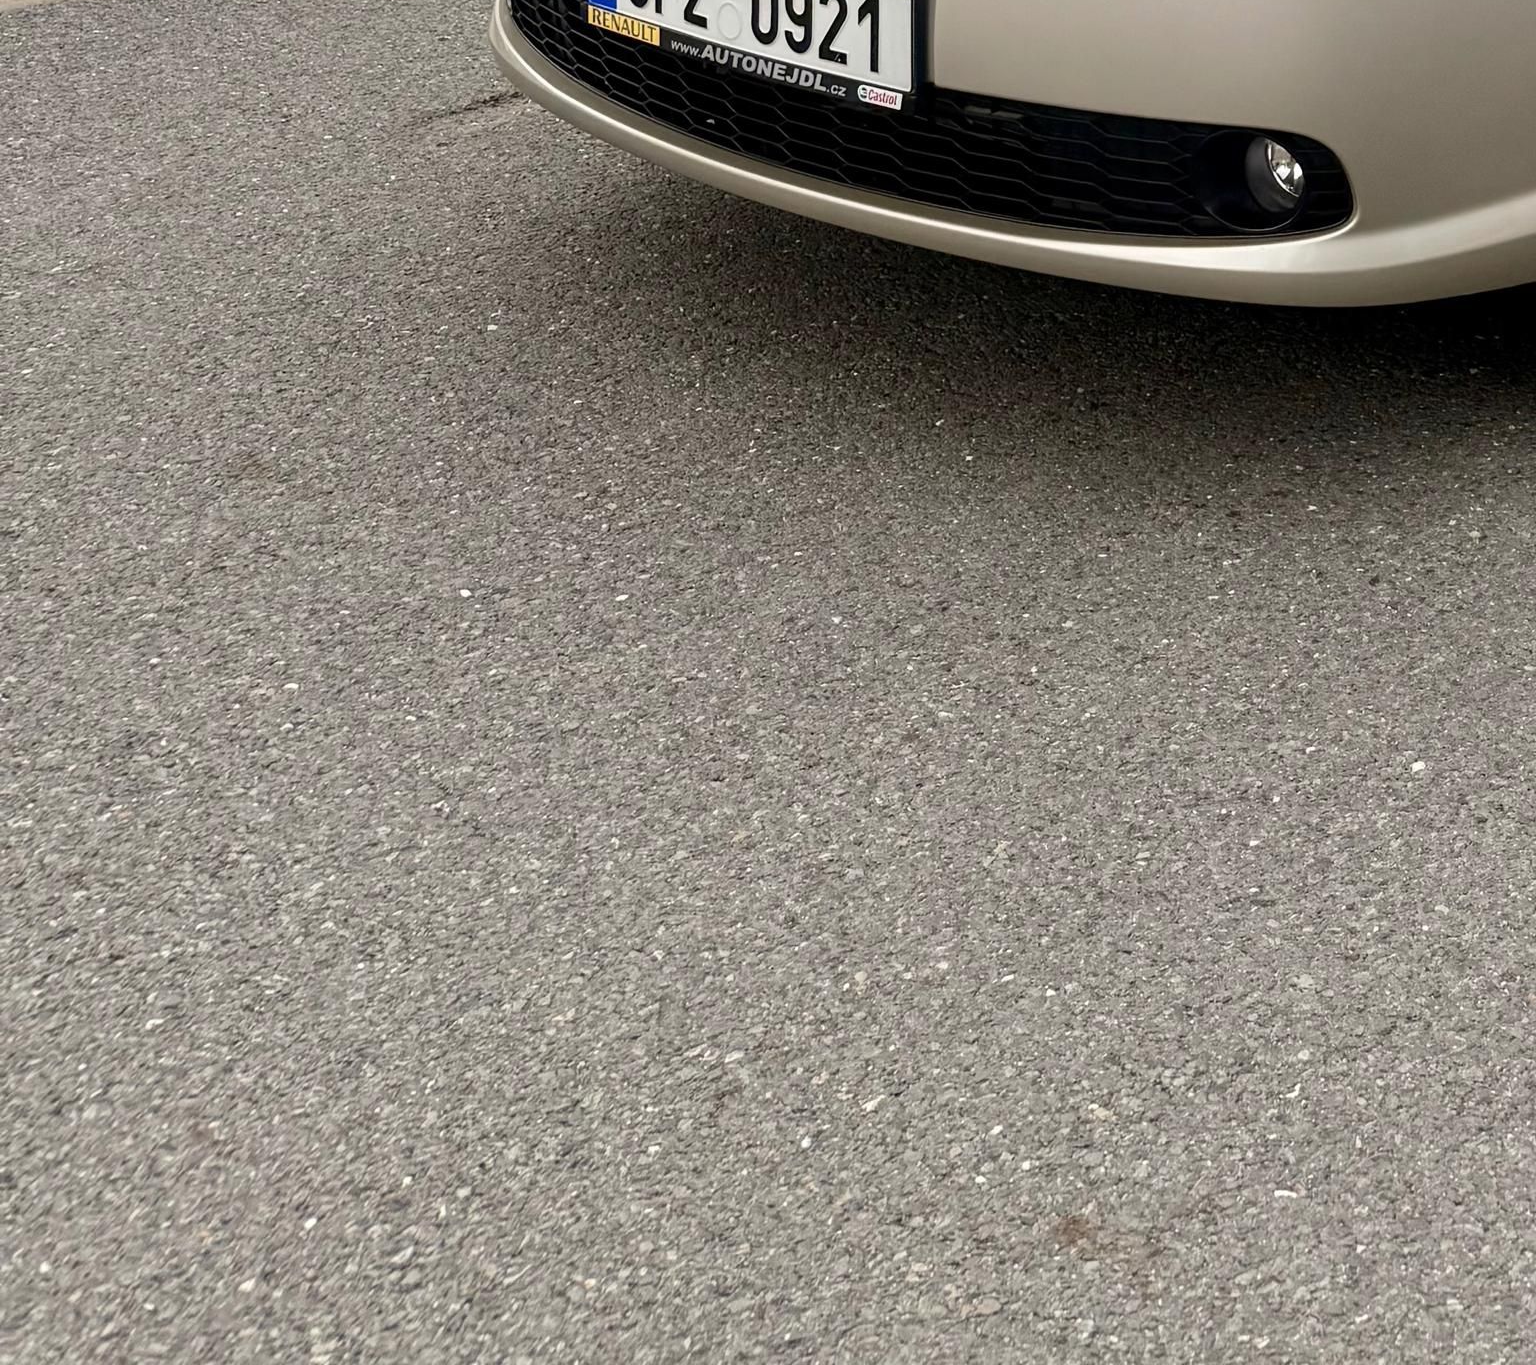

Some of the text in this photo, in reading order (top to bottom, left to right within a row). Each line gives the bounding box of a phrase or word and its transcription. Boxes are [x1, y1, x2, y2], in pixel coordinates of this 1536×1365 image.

[592, 8, 657, 43] RENAULT
[671, 39, 847, 97] www.AUTONEJDL.cz
[868, 89, 898, 106] Castrol
